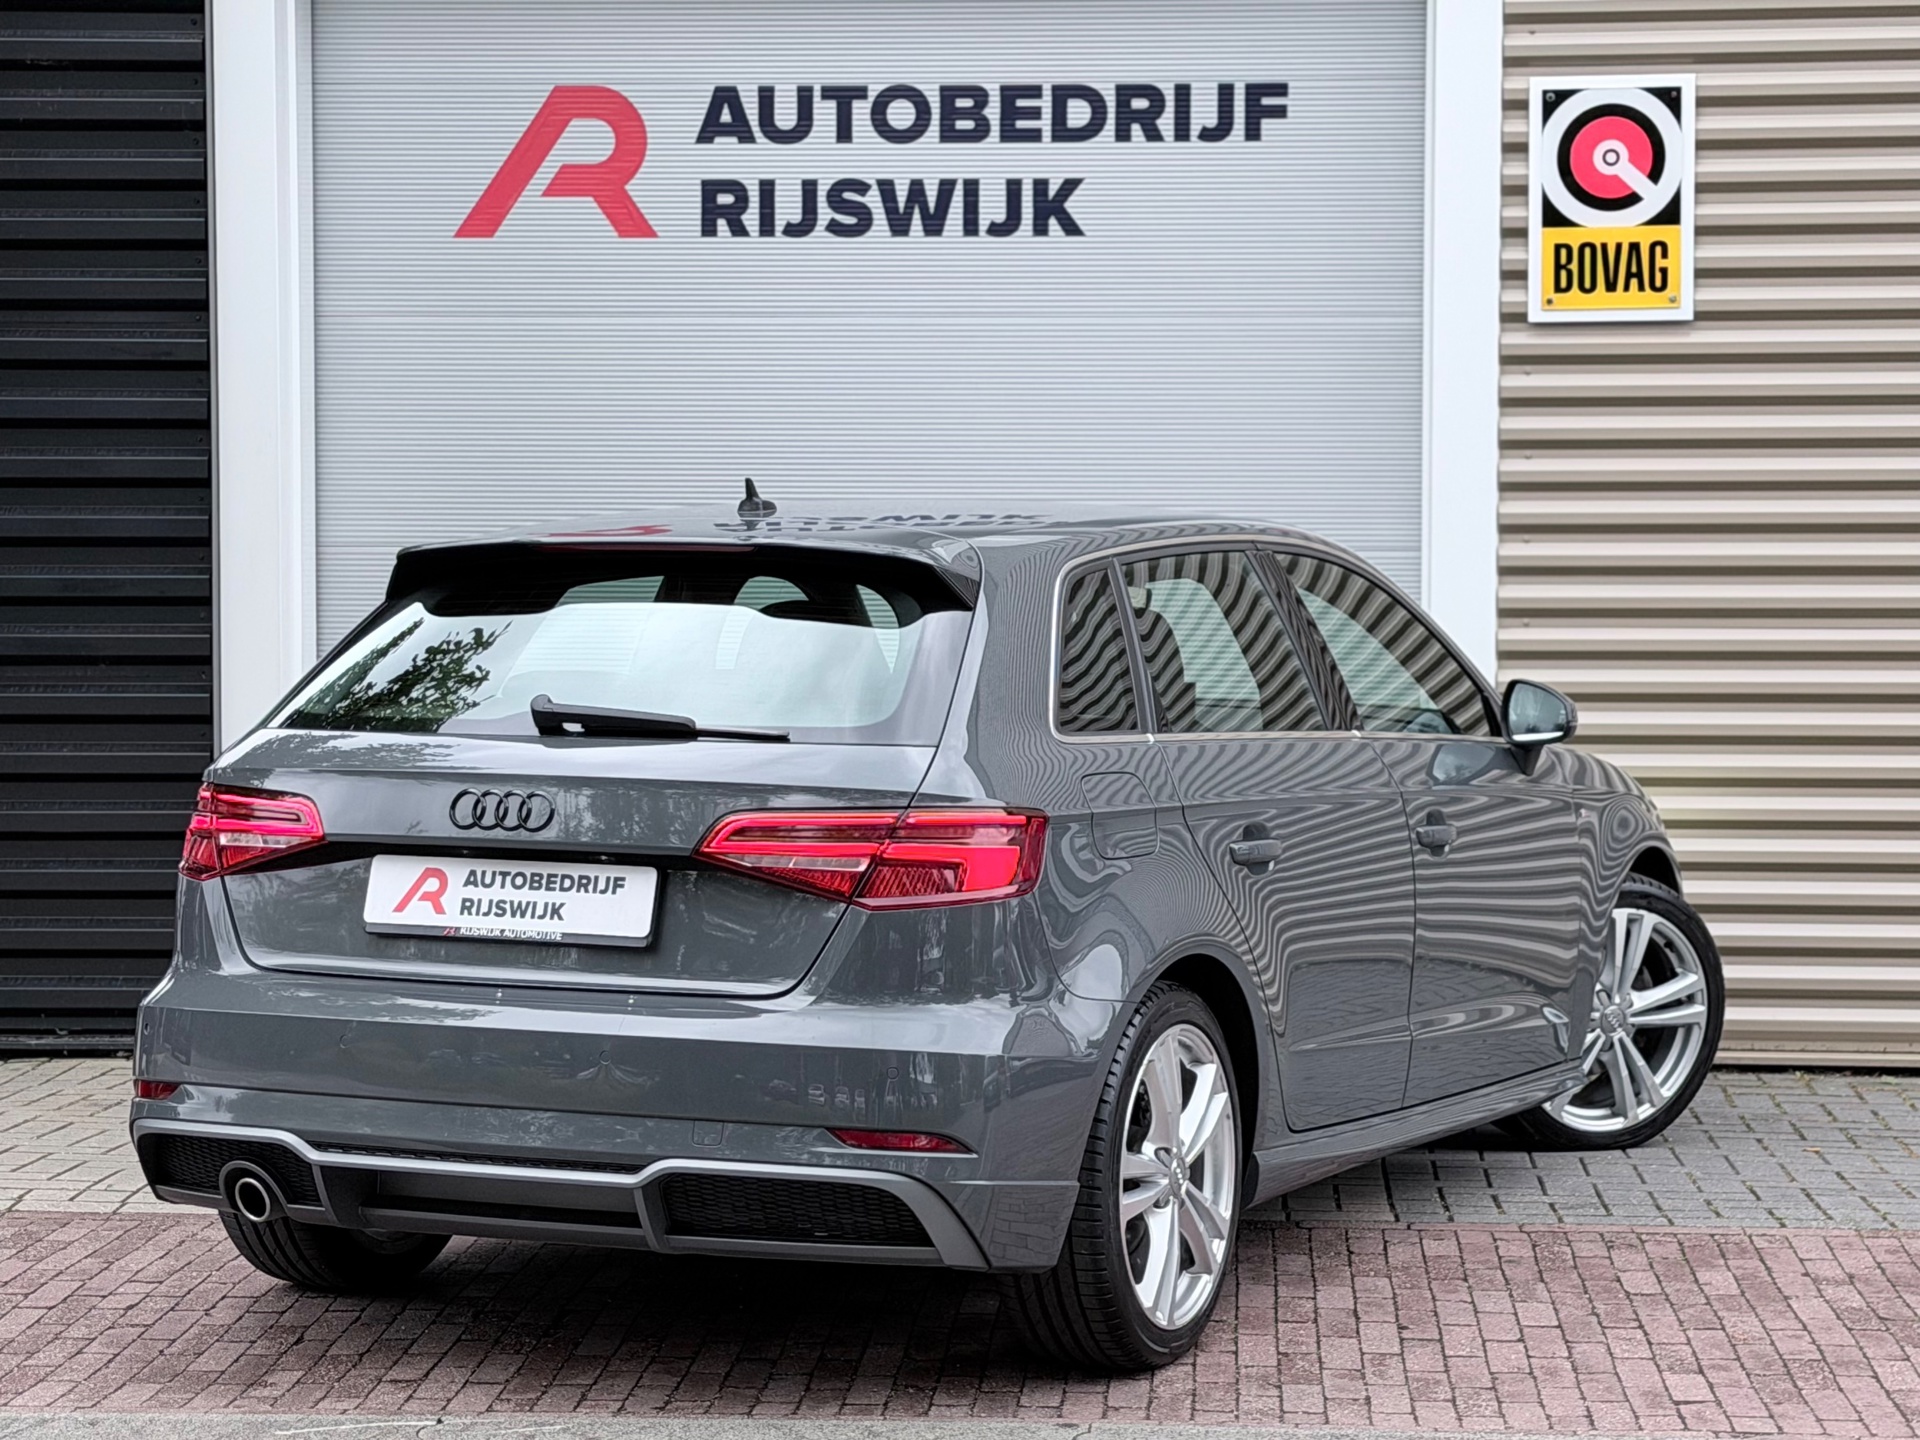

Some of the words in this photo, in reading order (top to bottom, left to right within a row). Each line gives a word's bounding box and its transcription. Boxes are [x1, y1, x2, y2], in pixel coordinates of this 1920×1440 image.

[695, 82, 1289, 145] AUTOBEDRIJF
[700, 178, 1085, 238] RIJSWIJK
[1553, 240, 1669, 295] BOVAG
[462, 869, 627, 896] AUTOBEDRIJF
[459, 897, 566, 921] RIJSWIJK
[460, 927, 502, 937] RIJSWIJK
[503, 928, 563, 940] AUTOMOTIVE
